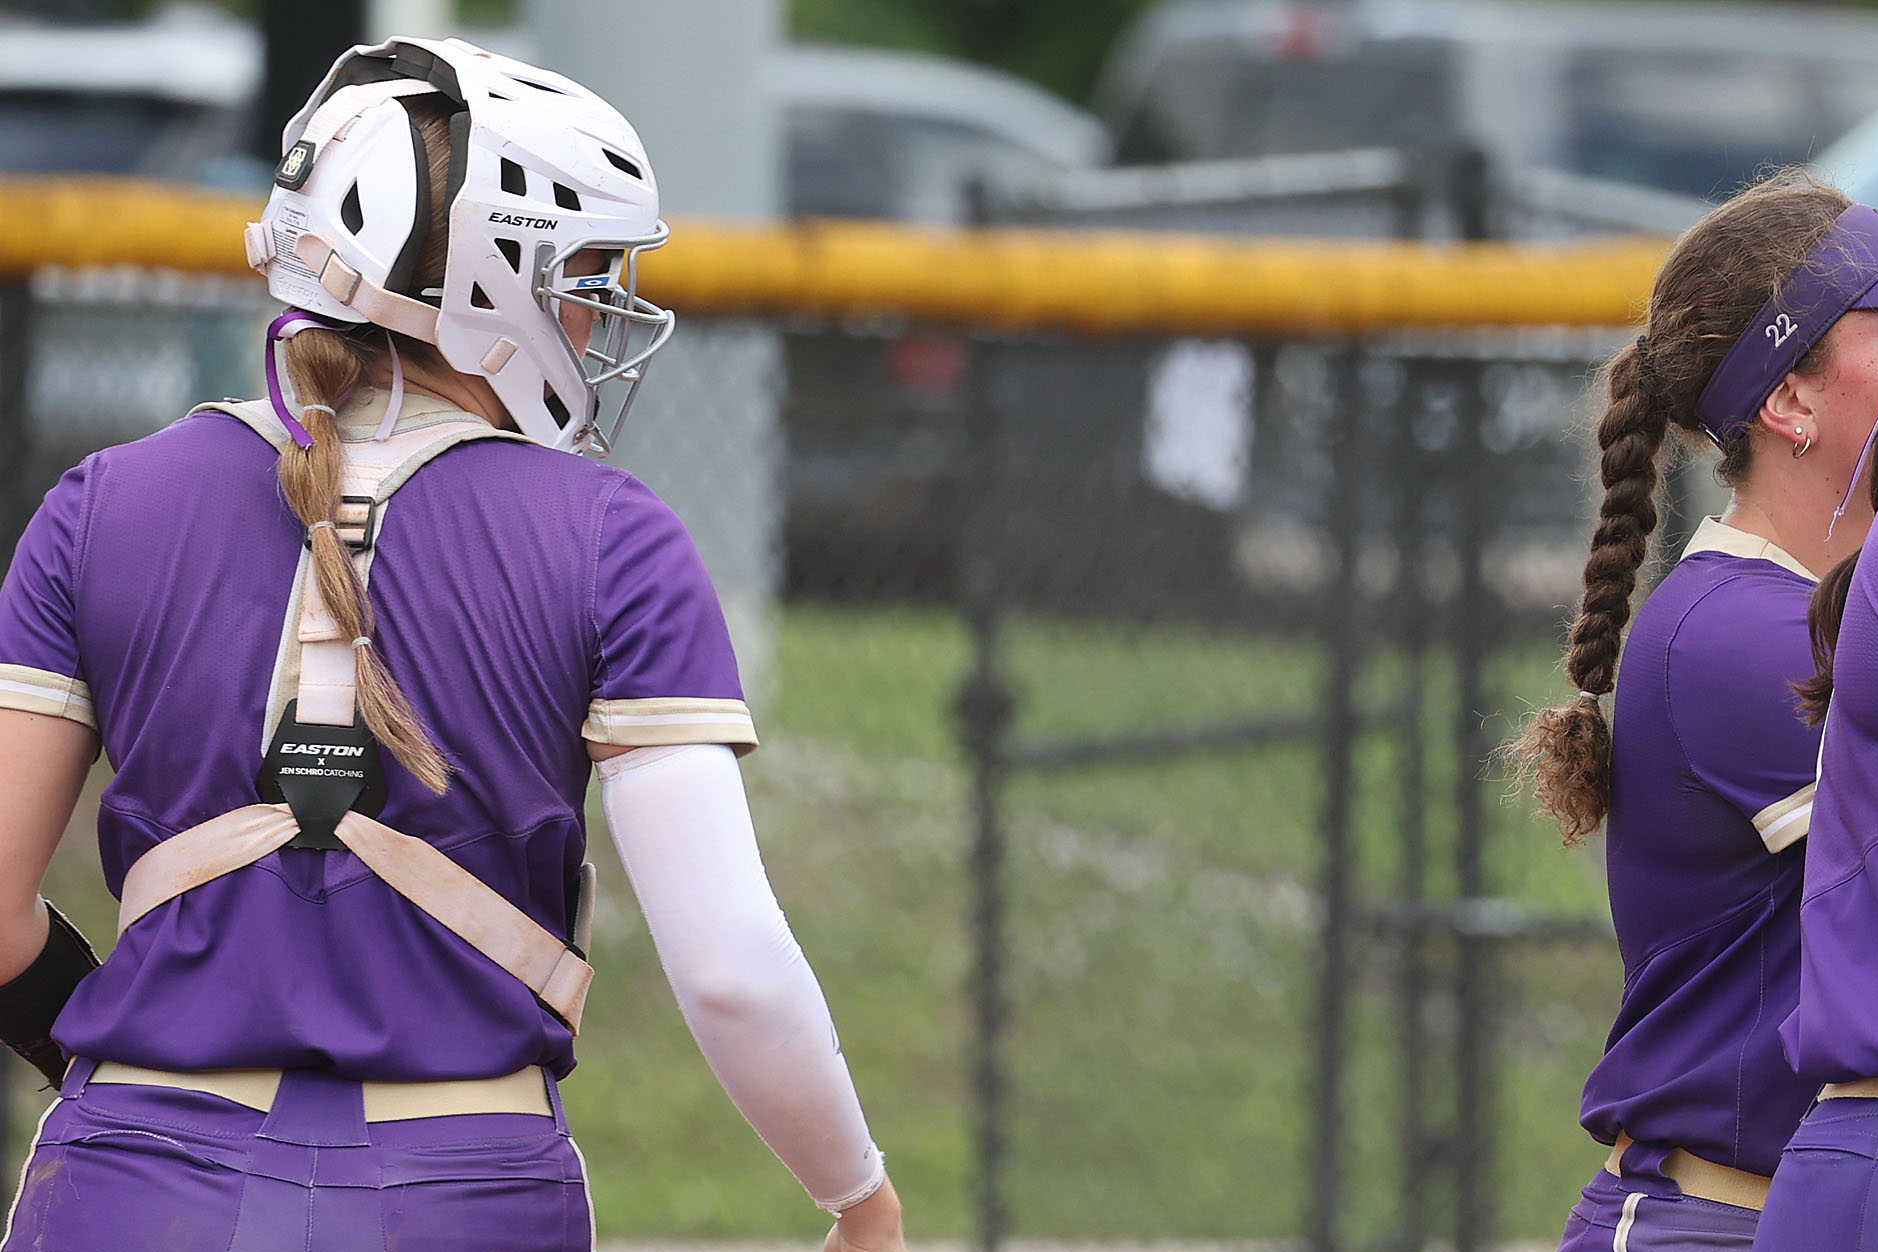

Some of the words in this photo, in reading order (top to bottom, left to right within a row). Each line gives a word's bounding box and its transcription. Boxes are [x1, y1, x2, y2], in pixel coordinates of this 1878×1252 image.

[487, 212, 559, 231] EASTON
[1765, 313, 1799, 348] 22
[280, 743, 365, 757] EASTON
[278, 767, 295, 775] JEN
[295, 767, 324, 776] SCHRO
[324, 768, 364, 778] CATCHING
